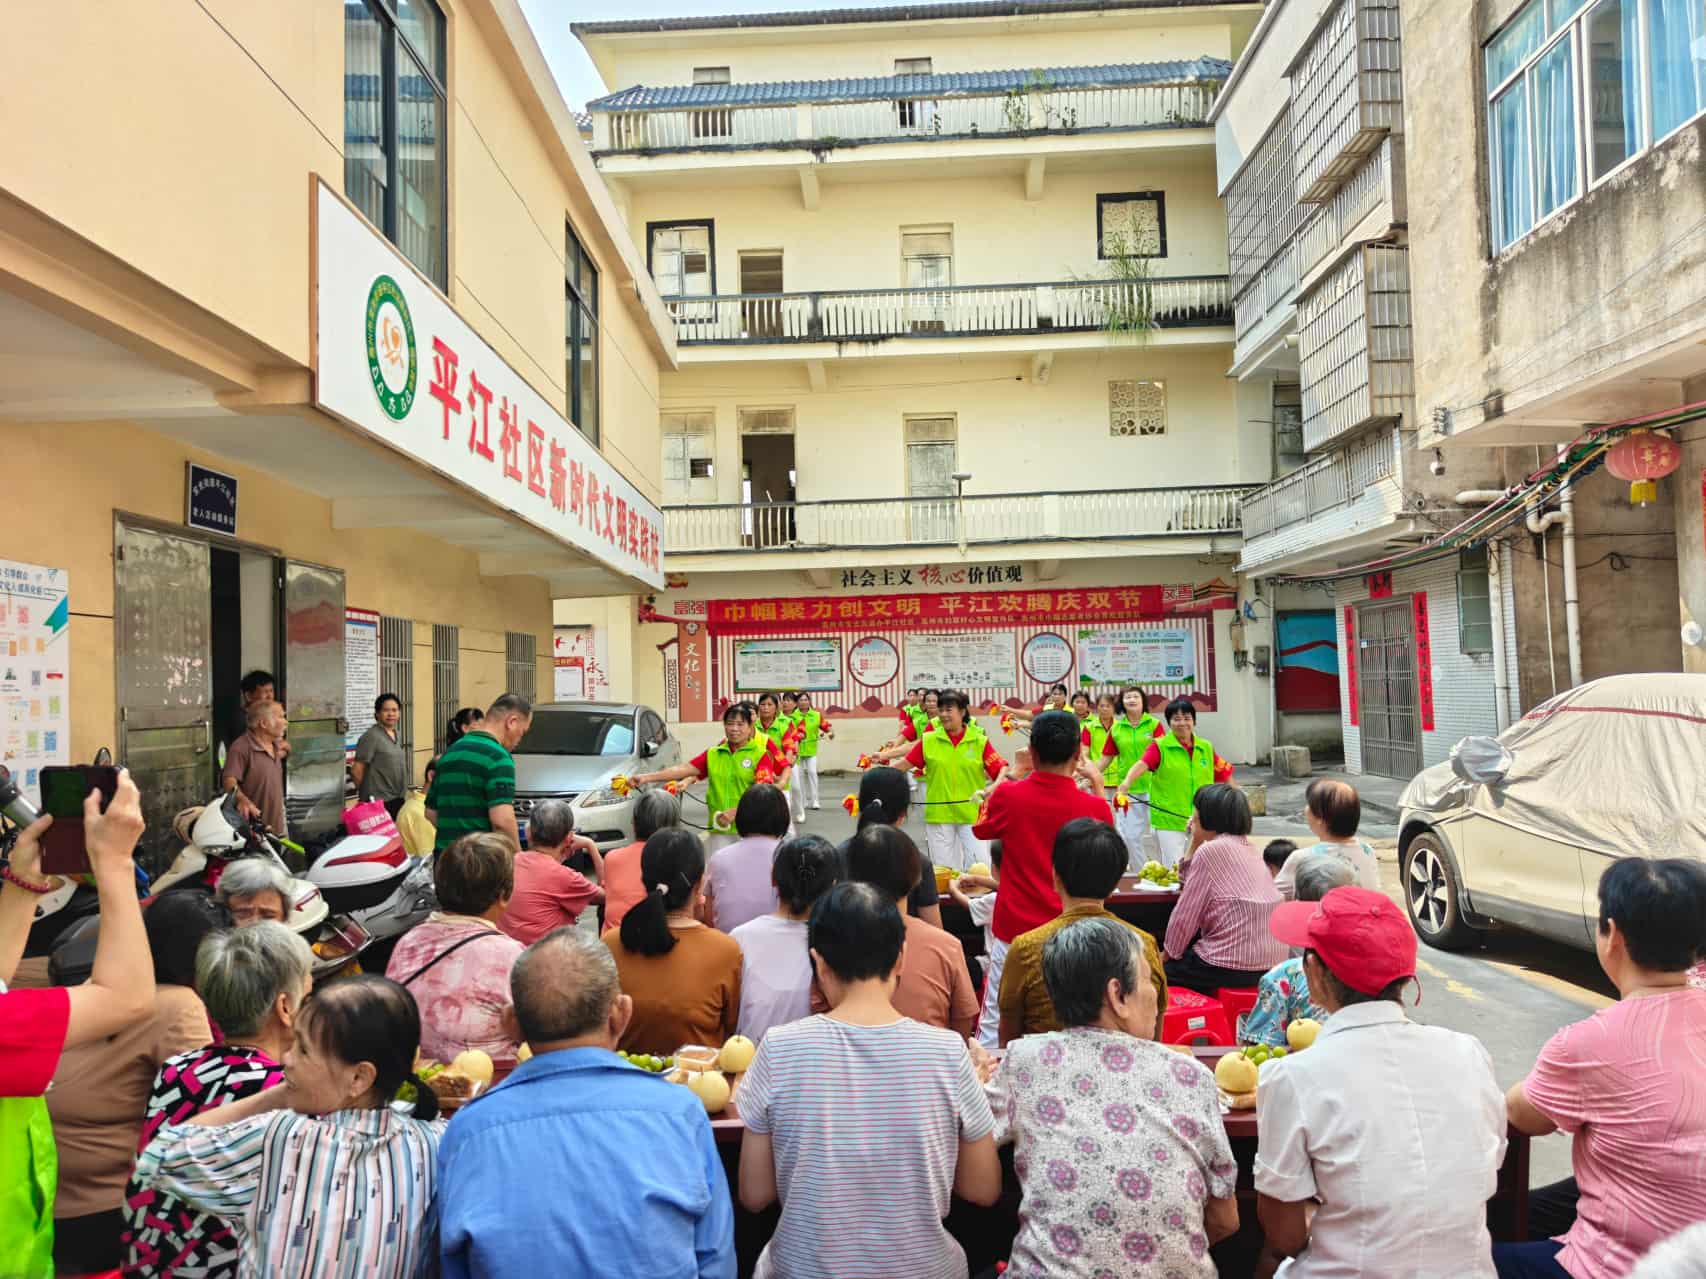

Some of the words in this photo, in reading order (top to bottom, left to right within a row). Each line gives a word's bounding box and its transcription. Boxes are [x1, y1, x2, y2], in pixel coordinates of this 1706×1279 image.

[428, 335, 660, 573] 平江社区新时代文明实践站
[841, 564, 1023, 588] 社会主义核心价值观
[724, 597, 921, 621] 巾帼聚力创文明
[939, 590, 1142, 614] 平江欢腾庆双节
